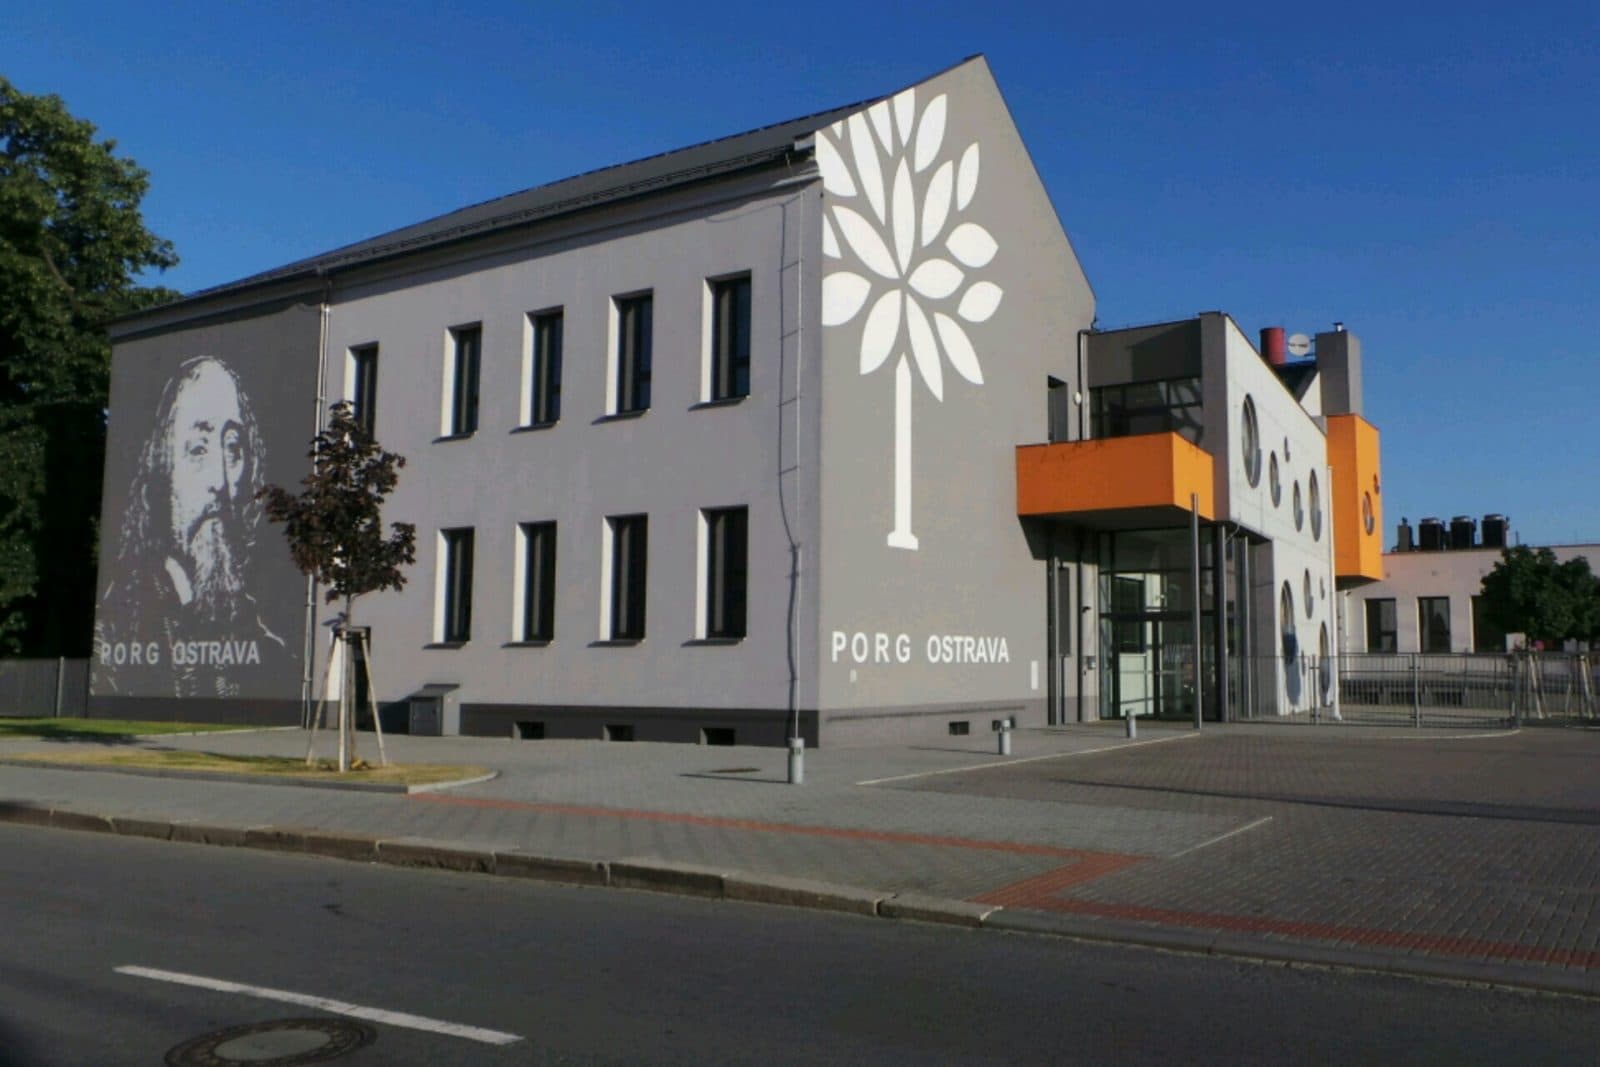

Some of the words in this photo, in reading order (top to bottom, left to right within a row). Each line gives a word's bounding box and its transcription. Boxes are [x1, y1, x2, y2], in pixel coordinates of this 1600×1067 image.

[101, 641, 159, 665] PORG
[172, 640, 260, 665] OSTRAVA
[831, 631, 911, 663] PORG
[926, 634, 1009, 663] OSTRAVA
